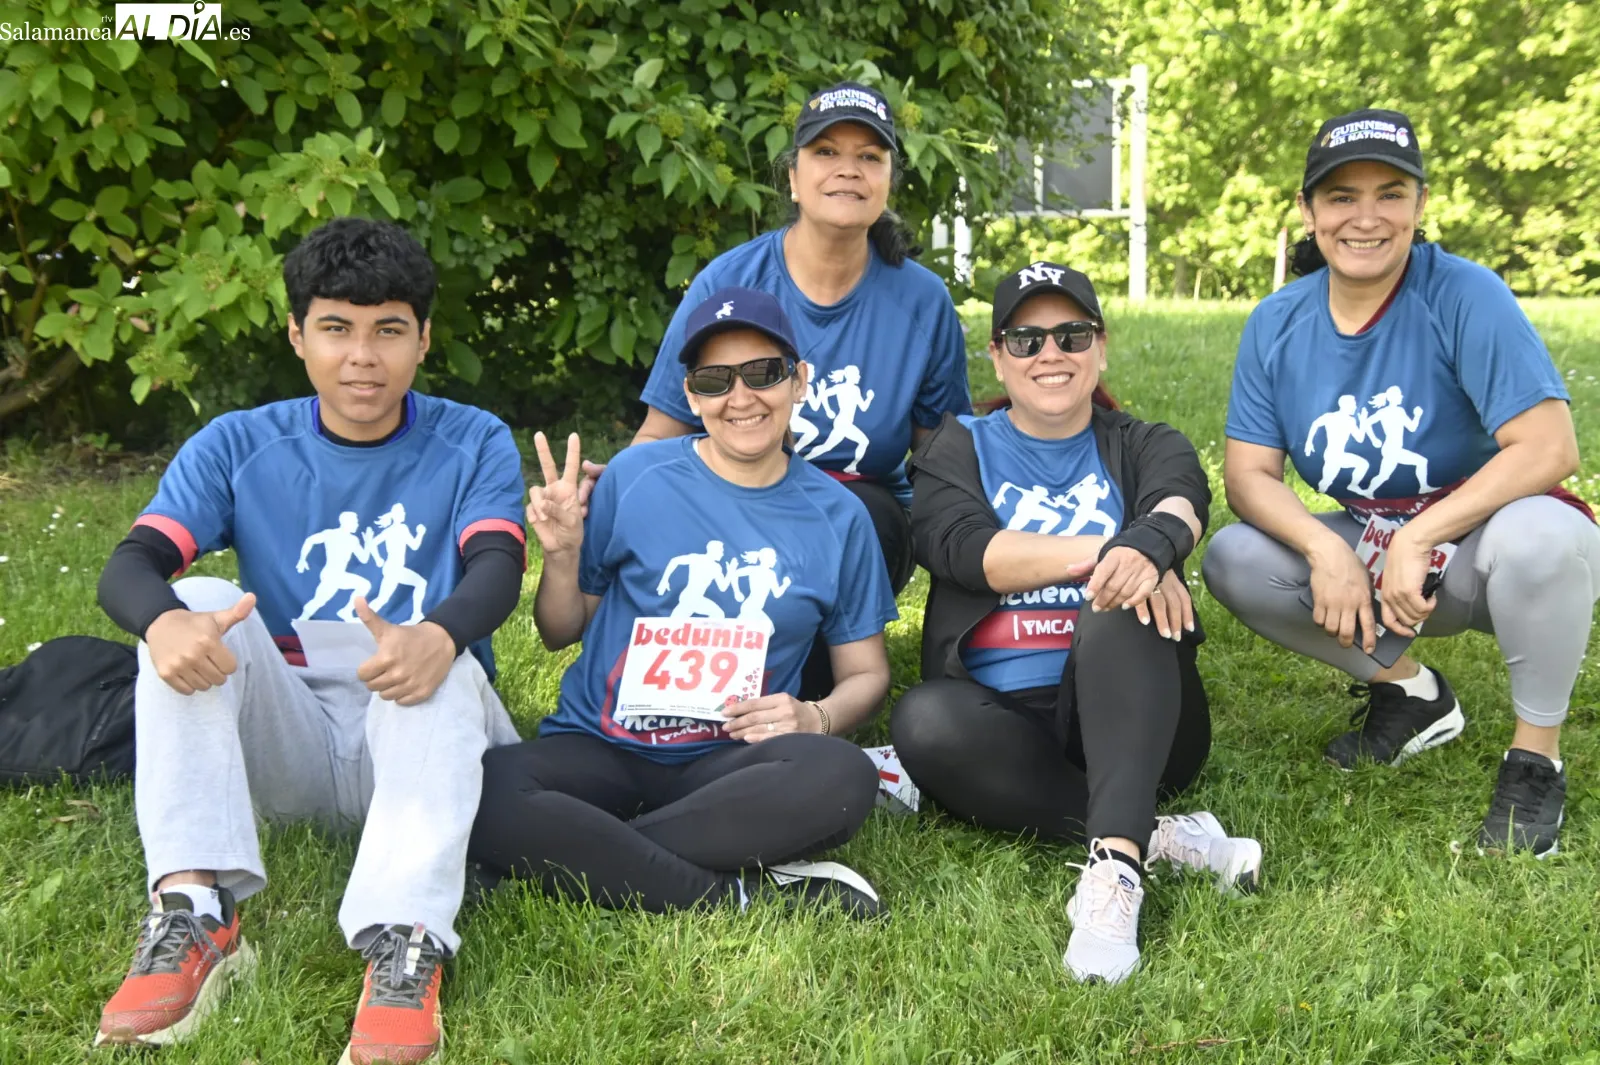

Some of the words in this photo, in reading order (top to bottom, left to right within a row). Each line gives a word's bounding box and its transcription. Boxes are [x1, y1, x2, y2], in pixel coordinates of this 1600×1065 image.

[1330, 119, 1397, 139] GUINNESS
[1348, 130, 1397, 143] NATIONS
[1018, 261, 1066, 290] NY
[633, 622, 765, 650] bedunia
[1022, 619, 1075, 636] YMCA
[642, 649, 739, 694] 439
